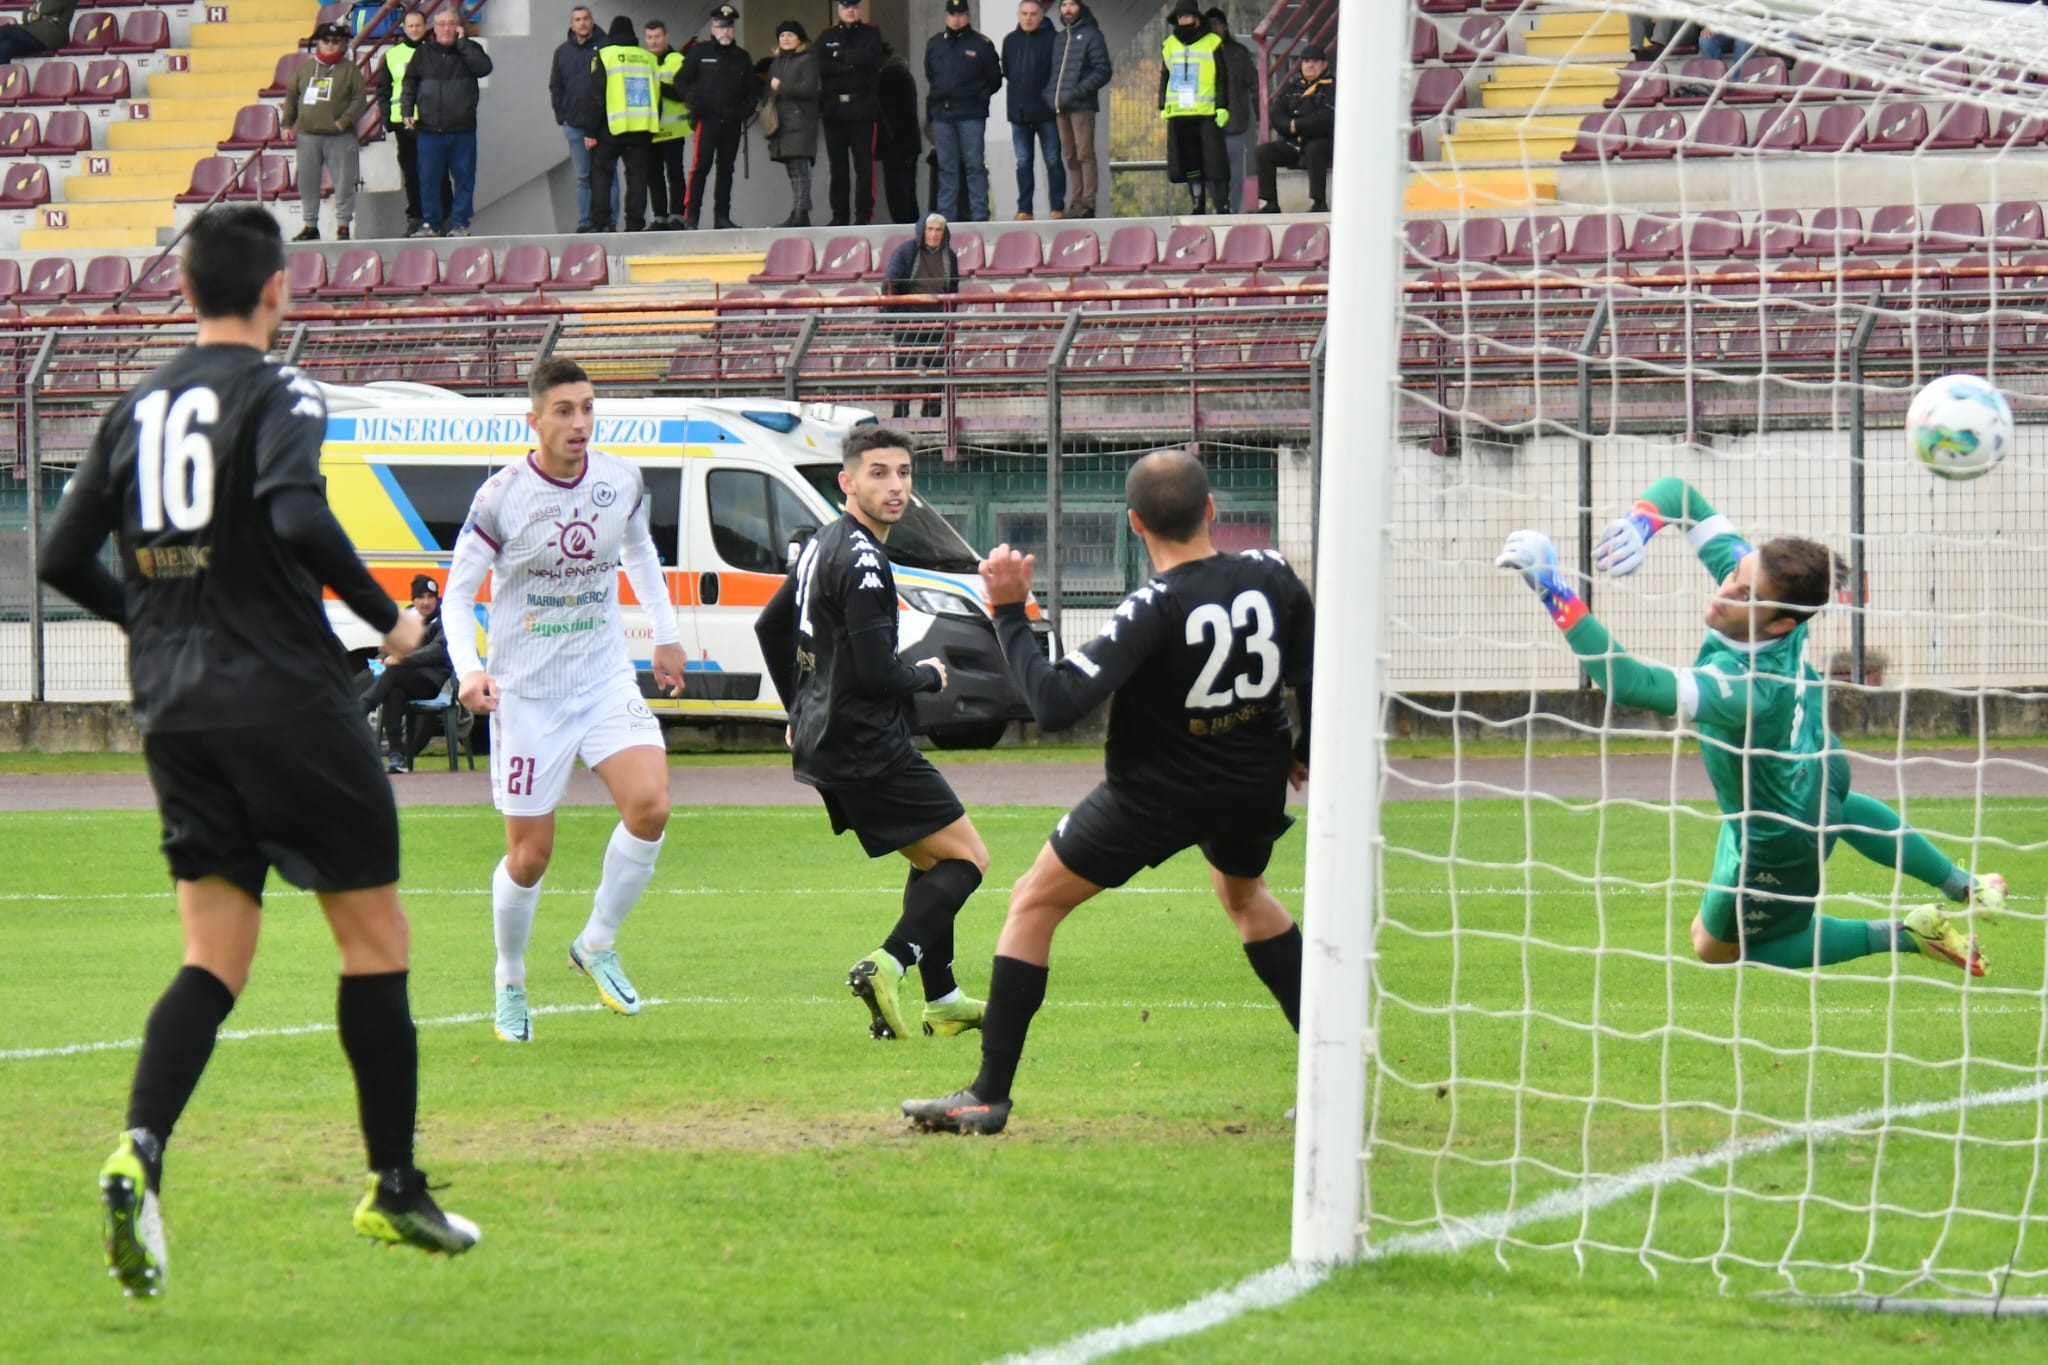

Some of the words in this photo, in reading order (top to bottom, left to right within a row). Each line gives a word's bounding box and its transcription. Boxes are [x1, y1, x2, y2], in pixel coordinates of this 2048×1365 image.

[211, 9, 223, 21] H
[134, 105, 145, 118] L
[92, 159, 107, 173] M
[50, 212, 63, 226] N
[355, 417, 532, 442] MISERICORDI
[594, 419, 657, 443] EZZO
[133, 386, 220, 532] 16
[1184, 589, 1281, 709] 23
[507, 756, 536, 796] 21
